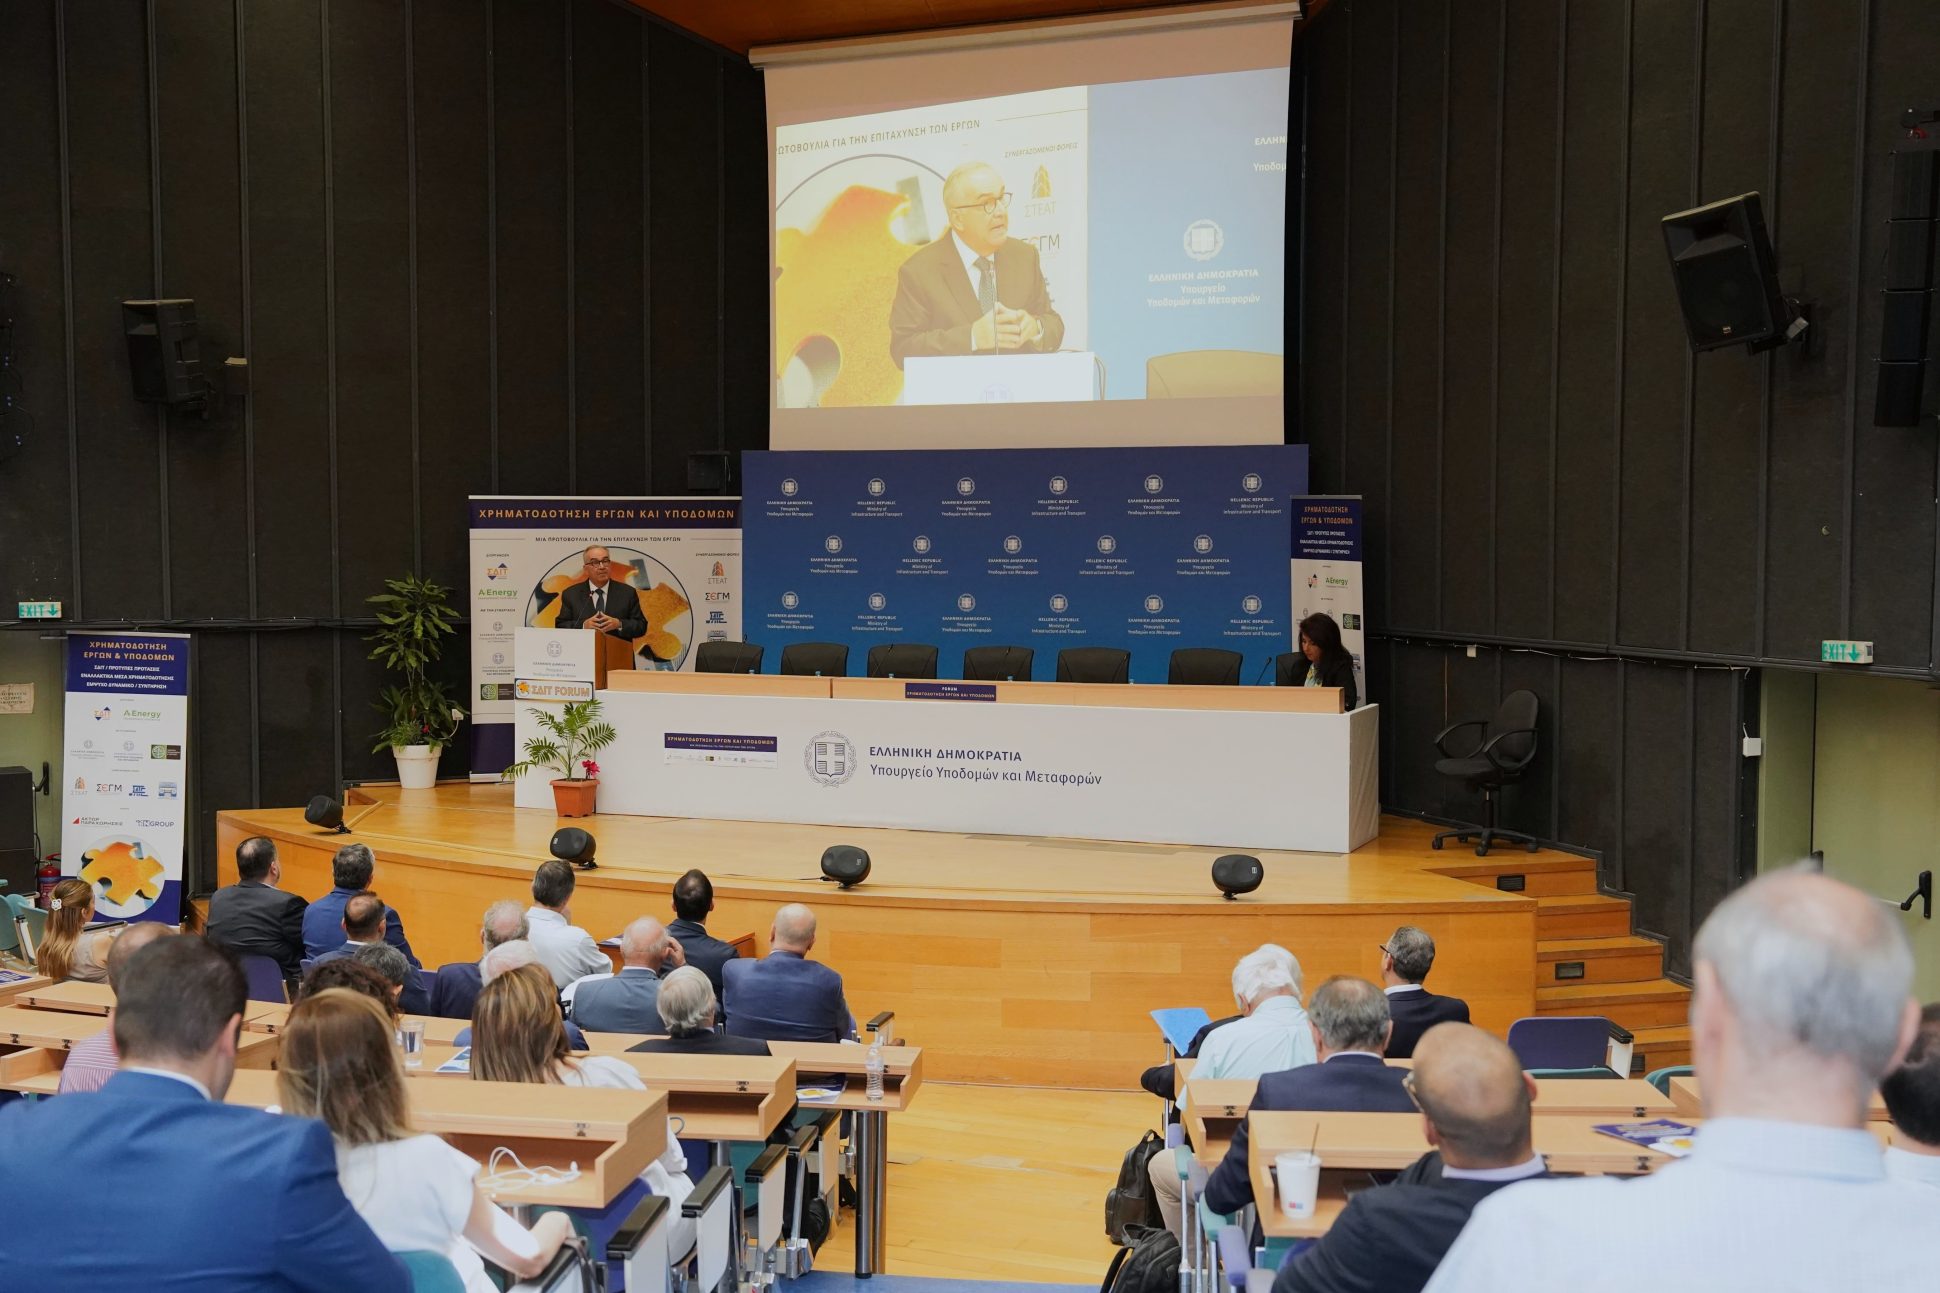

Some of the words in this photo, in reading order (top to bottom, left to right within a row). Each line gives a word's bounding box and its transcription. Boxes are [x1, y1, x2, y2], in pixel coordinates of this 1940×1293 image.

[832, 138, 847, 148] ΓΙΑ
[849, 134, 868, 145] ΤΗΝ
[871, 127, 926, 142] ΕΠΙΤΑΧΥΝΣΗ
[930, 122, 948, 134] ΤΩΝ
[951, 119, 980, 131] ΕΡΓΩΝ
[1024, 201, 1056, 218] ΣΤΕΑΤ
[1148, 271, 1194, 283] ΕΛΛΗΝΙΚΗ
[1196, 268, 1259, 281] ΔΗΜΟΚΡΑΤΙΑ
[479, 509, 590, 519] ΧΡΗΜΑΤΟΔΟΤΗΣΗ
[595, 509, 634, 519] ΕΡΓΩΝ
[639, 509, 660, 519] ΚΑΙ
[664, 509, 735, 519] ΥΠΟΔΟΜΩΝ
[707, 577, 728, 585] ΣΤΕΑΤ
[19, 604, 44, 618] EXIT
[89, 641, 167, 651] ΧΡΗΜΑΤΟΔΟΤΗΣΗ
[1822, 642, 1847, 661] EXIT
[83, 651, 112, 660] ΕΡΓΩΝ
[114, 652, 121, 660] &
[124, 652, 175, 662] ΥΠΟΔΟΜΩΝ
[554, 686, 590, 698] FORUM
[869, 746, 933, 759] ΕΛΛΗΝΙΚΗ
[936, 748, 1022, 762] ΔΗΜΟΚΡΑΤΙΑ
[870, 763, 934, 780] Υπουργείο
[936, 765, 999, 782] Υποδομών
[1002, 770, 1022, 783] και
[1025, 769, 1102, 787] Μεταφορών
